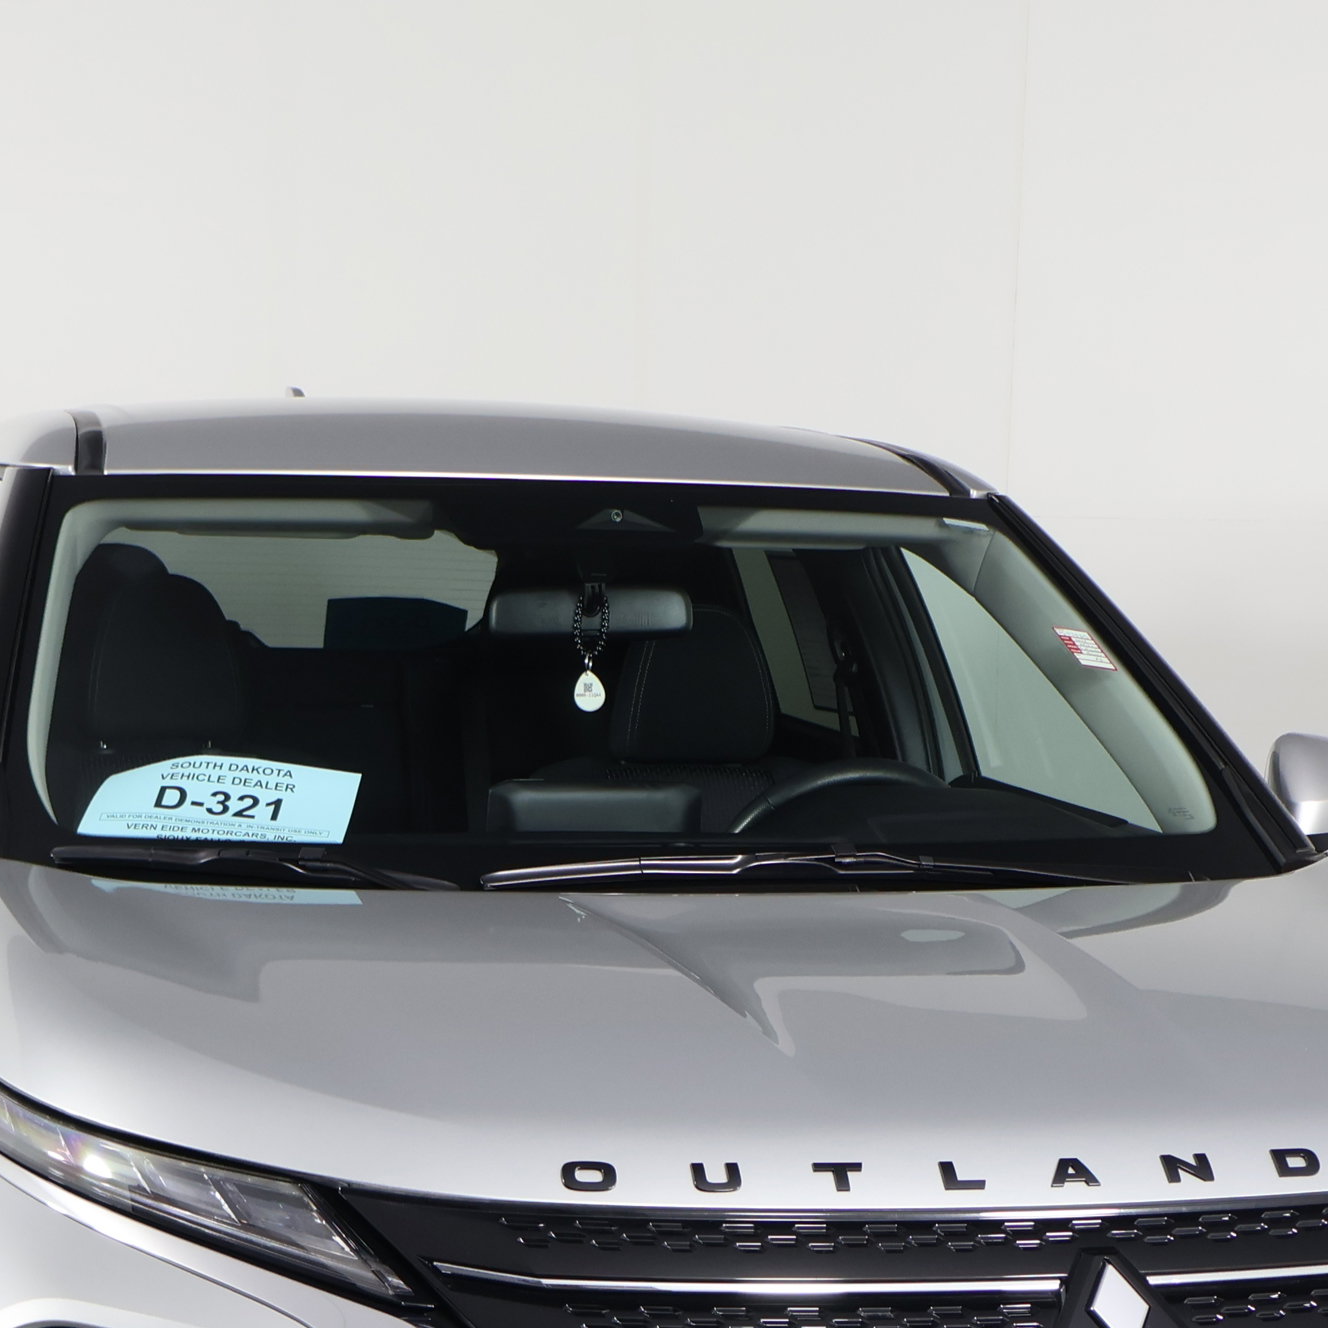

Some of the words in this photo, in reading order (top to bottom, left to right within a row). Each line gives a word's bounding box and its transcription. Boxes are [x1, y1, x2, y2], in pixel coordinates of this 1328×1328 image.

[170, 761, 224, 771] SOUTH
[228, 763, 294, 779] DAKOTA
[160, 772, 227, 785] VEHICLE
[231, 776, 296, 793] DEALER
[153, 785, 284, 822] D-321
[126, 823, 158, 831] VERN
[161, 824, 189, 833] EIDE
[191, 827, 270, 841] MOTORCARS,
[273, 835, 297, 843] INC.
